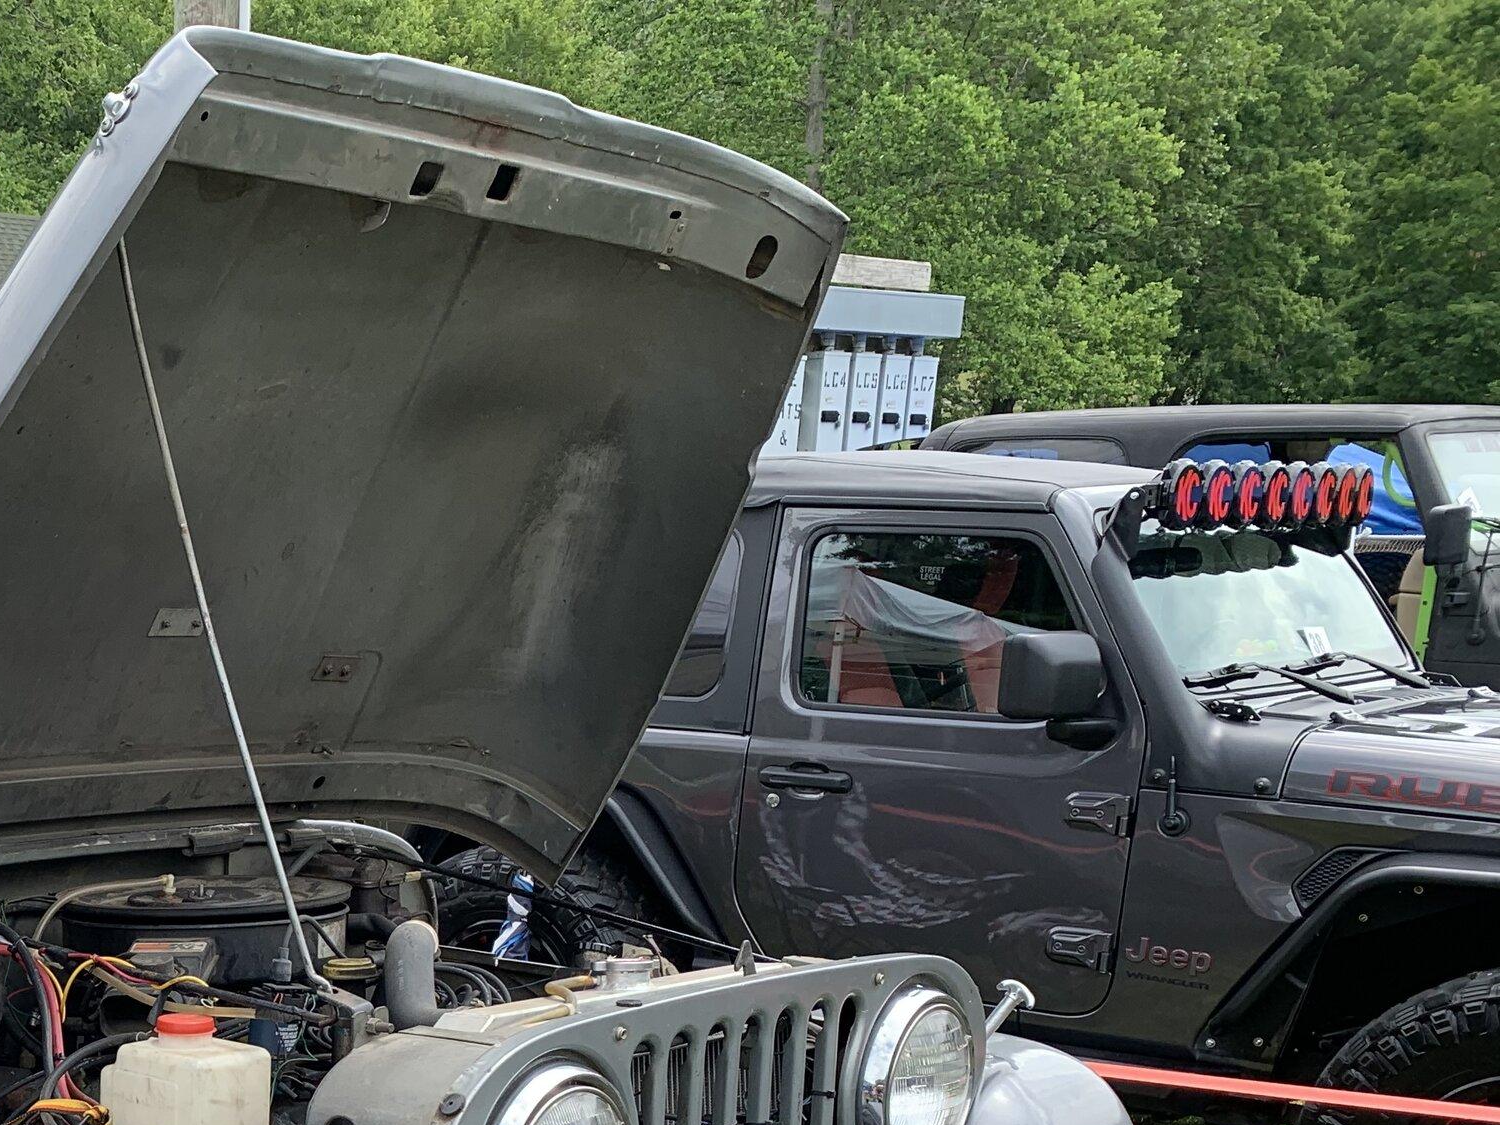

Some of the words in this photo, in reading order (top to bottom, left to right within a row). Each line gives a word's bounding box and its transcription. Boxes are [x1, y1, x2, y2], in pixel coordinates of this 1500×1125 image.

[823, 371, 846, 388] LC4
[855, 372, 878, 389] LC5
[912, 376, 935, 392] LC7
[779, 429, 788, 446] &
[1125, 937, 1212, 976] Jeep
[1126, 971, 1209, 990] WRANGLER
